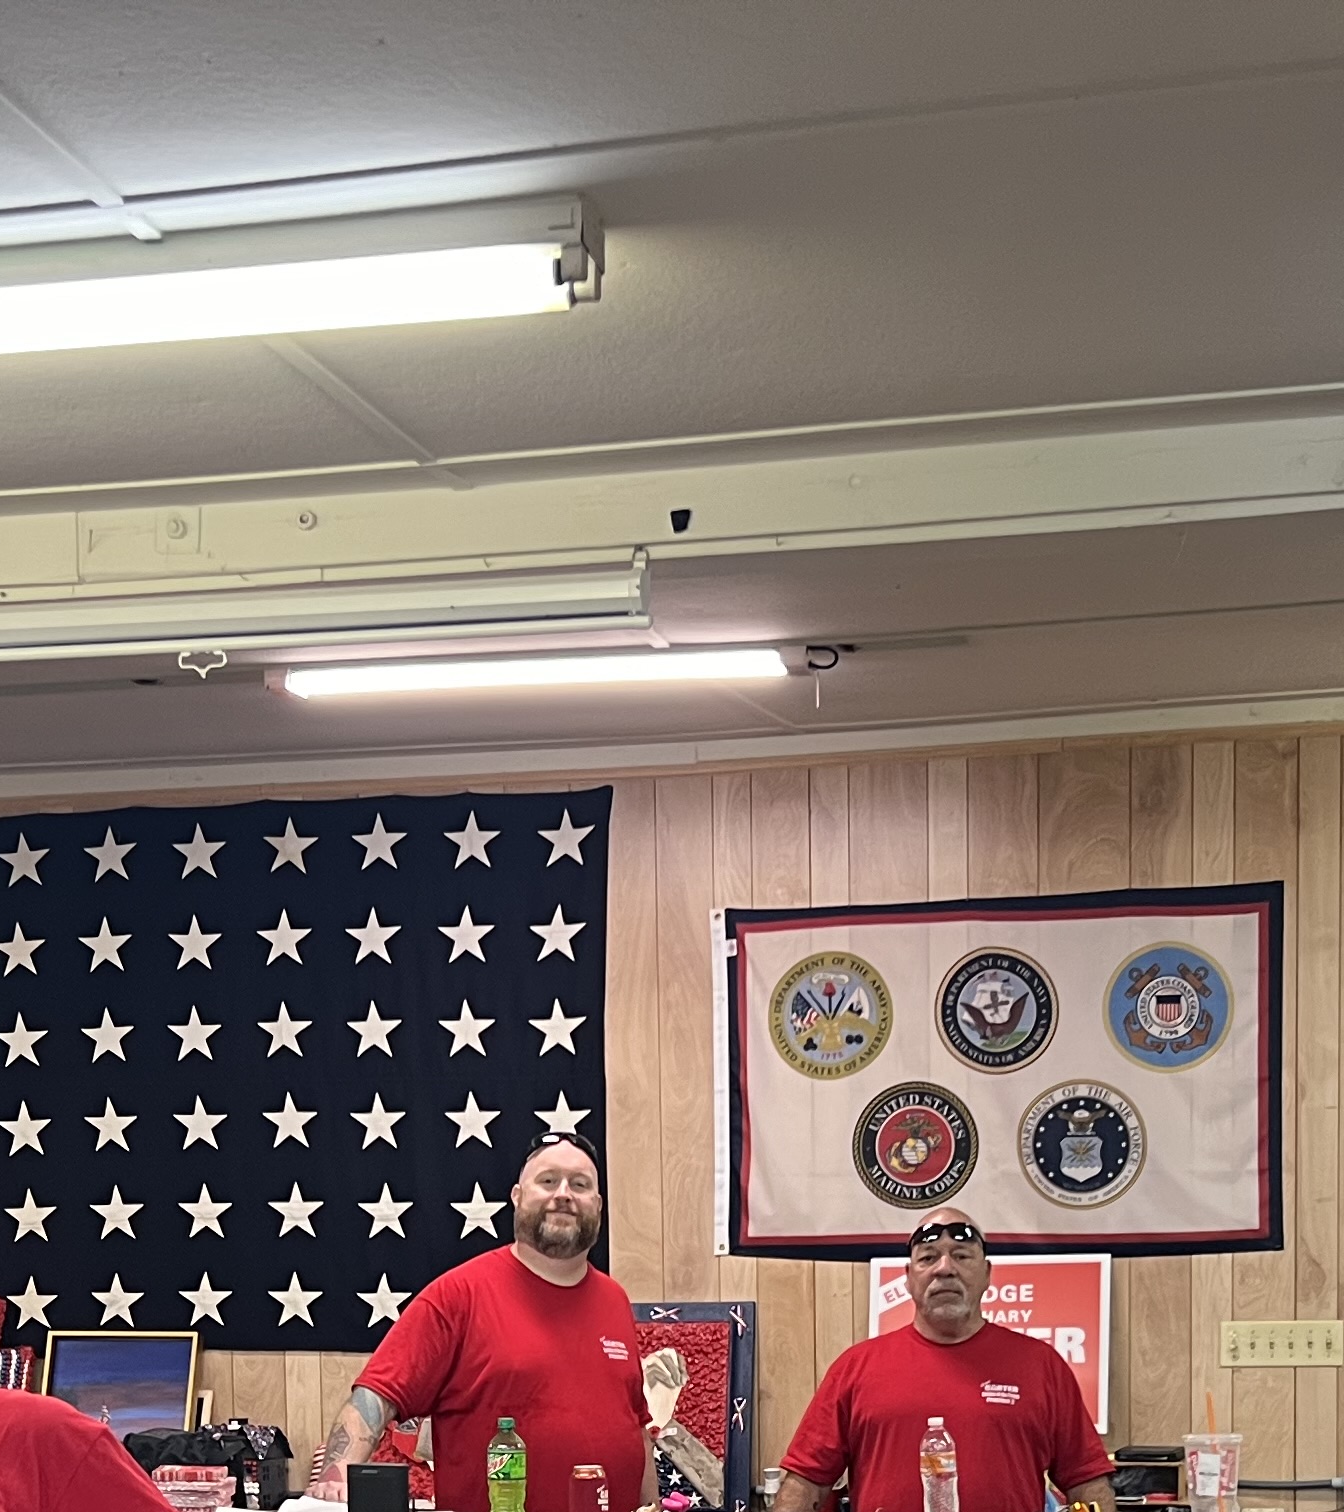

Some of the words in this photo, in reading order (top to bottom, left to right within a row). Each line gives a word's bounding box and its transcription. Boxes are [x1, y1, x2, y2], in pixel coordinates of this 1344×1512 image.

[774, 957, 826, 1015] DEPARTMENT
[831, 957, 846, 966] OF
[849, 960, 869, 977] THE
[869, 979, 889, 1012] ARMY
[774, 1023, 799, 1062] UNITED
[800, 1060, 842, 1076] STATES
[843, 1061, 858, 1072] OF
[859, 1016, 889, 1064] AMERICA
[868, 1093, 920, 1133] UNITED
[922, 1094, 967, 1140] STATES
[1022, 1094, 1056, 1166] DEPARTMENT
[1061, 1086, 1079, 1098] OF
[1086, 1085, 1111, 1101] THE
[1115, 1101, 1134, 1121] AIR
[1129, 1126, 1141, 1166] FORCE
[868, 1164, 923, 1199] MARINE
[924, 1160, 966, 1197] CORPS
[982, 1284, 1034, 1304] DGE
[982, 1309, 1032, 1324] HARY
